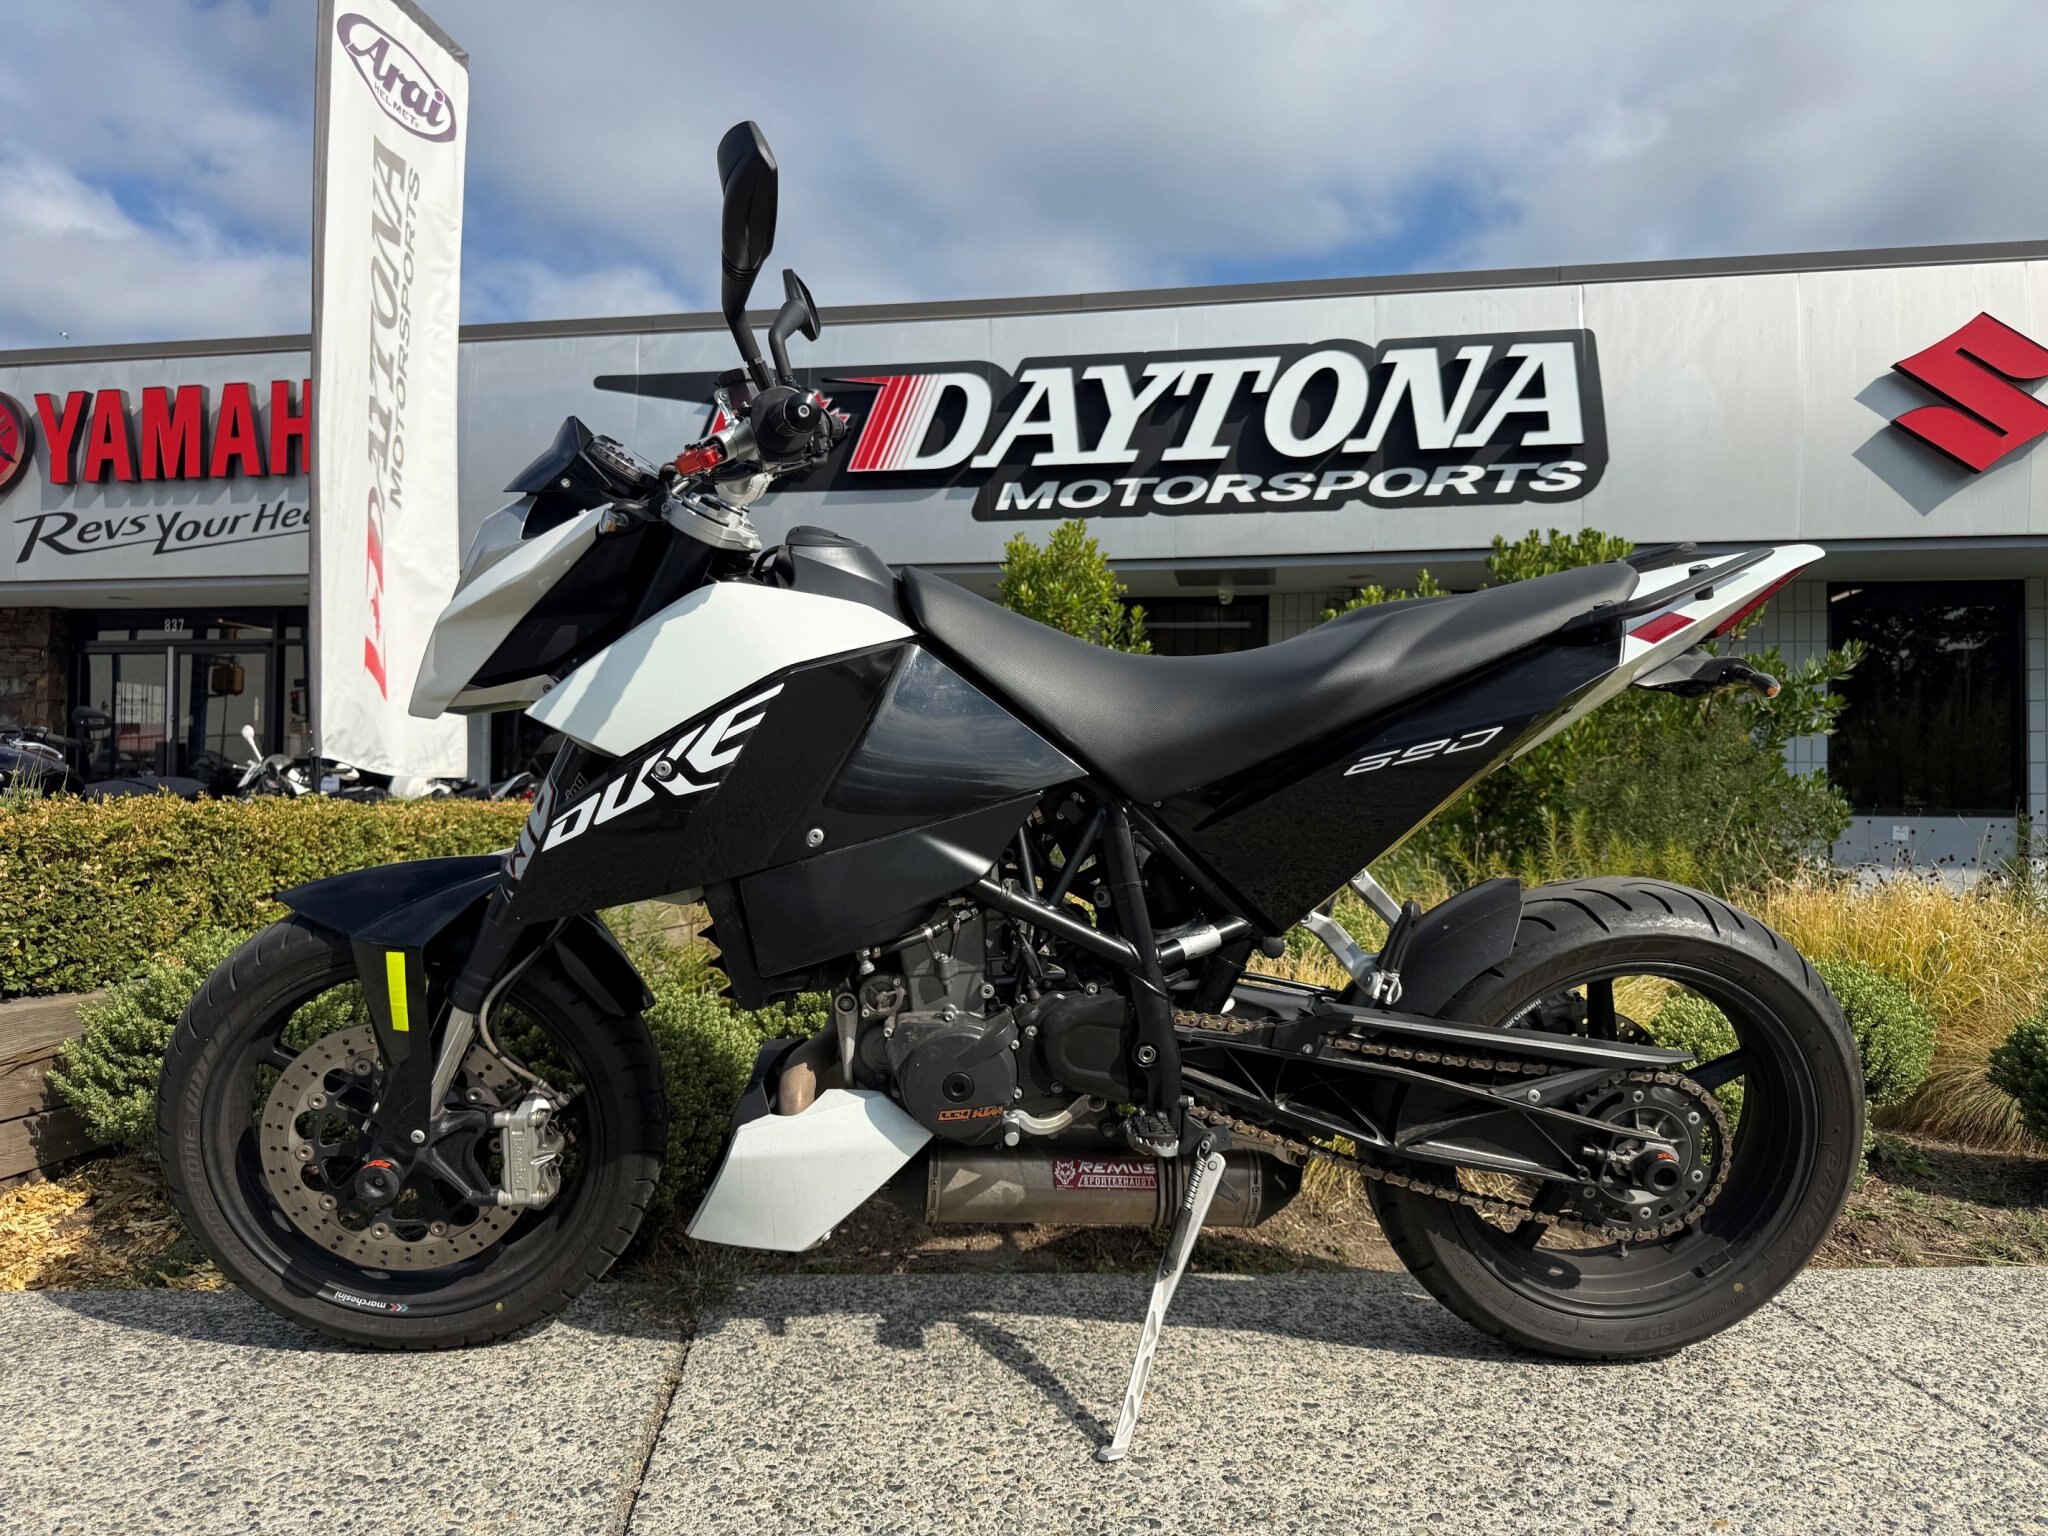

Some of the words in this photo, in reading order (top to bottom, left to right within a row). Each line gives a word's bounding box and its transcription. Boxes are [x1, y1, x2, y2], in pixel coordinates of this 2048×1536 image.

[347, 37, 446, 127] Arai
[389, 166, 420, 510] MOTORSPORTS
[365, 134, 407, 600] DAYTONA
[846, 341, 1585, 473] DAYTONA
[995, 460, 1588, 513] MOTORSPORTS
[13, 512, 150, 563] Revs
[152, 510, 251, 556] Your
[164, 618, 185, 632] 837
[541, 683, 785, 852] DUKE
[1078, 1161, 1157, 1174] REMUS
[1083, 1177, 1152, 1187] SPORTEXHAUST
[334, 1291, 387, 1309] marchesini
